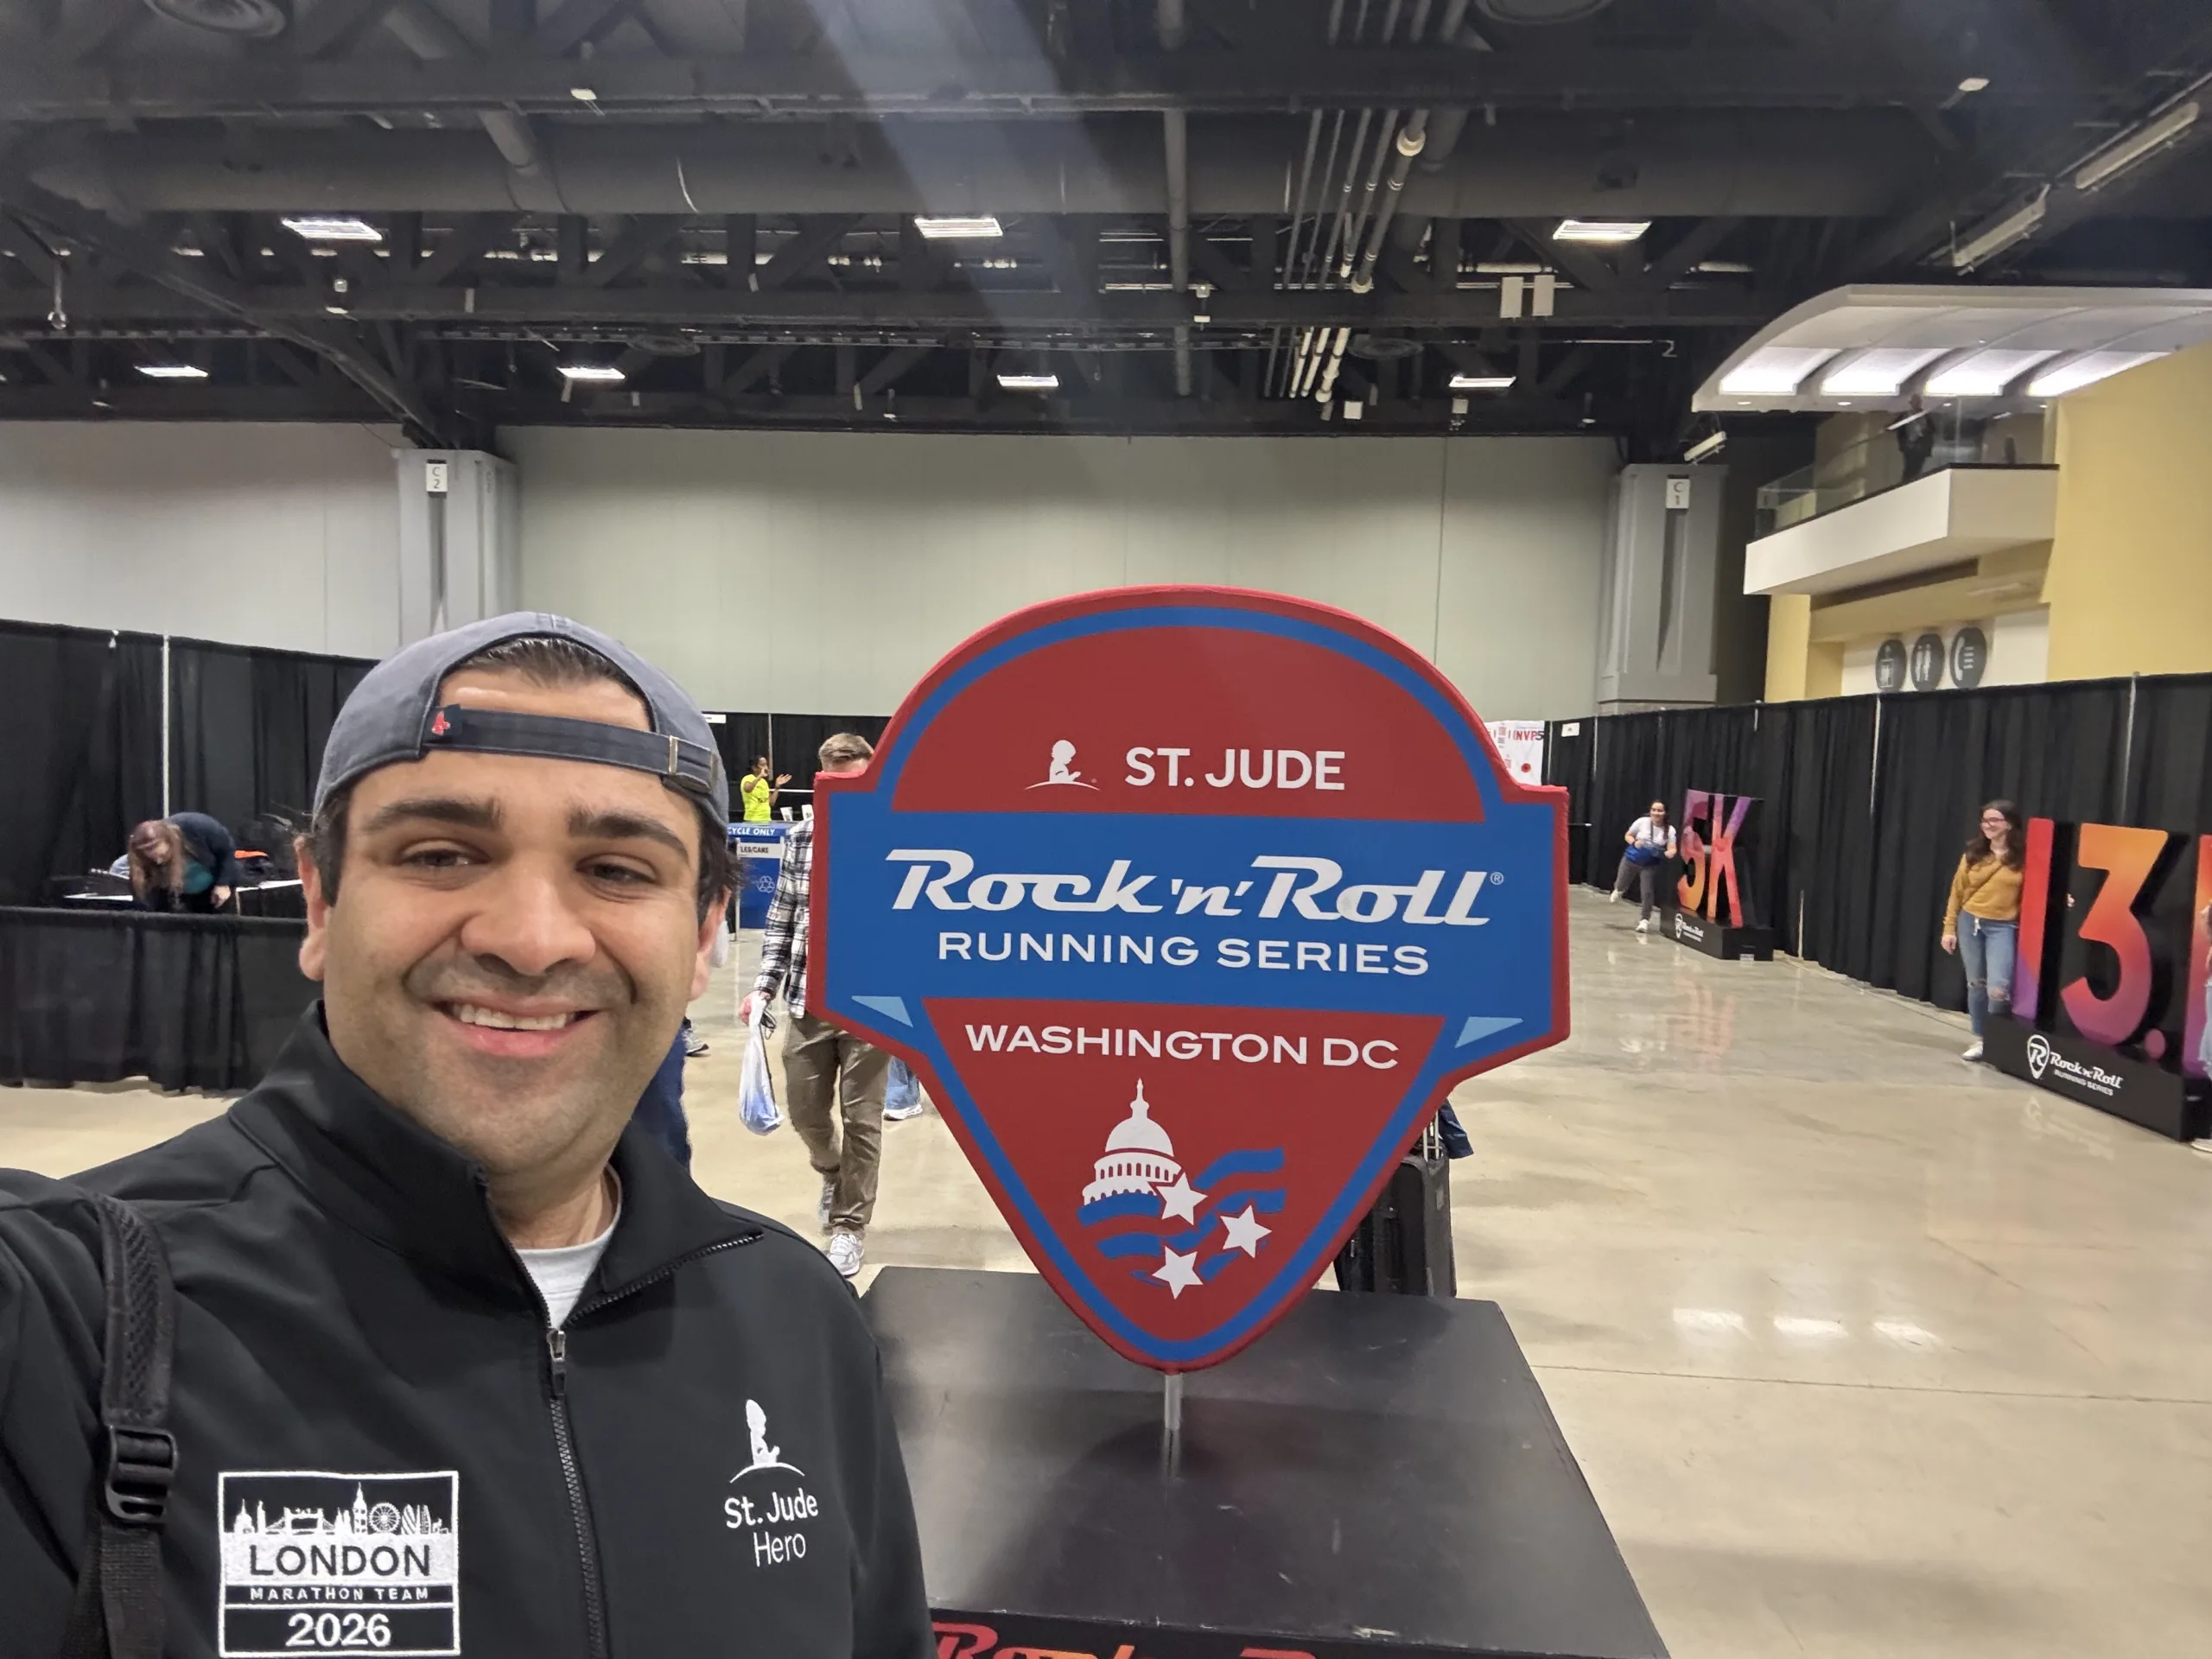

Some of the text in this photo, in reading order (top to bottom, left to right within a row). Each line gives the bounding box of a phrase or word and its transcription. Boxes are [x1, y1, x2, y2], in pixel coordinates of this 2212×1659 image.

[432, 467, 441, 477] C
[433, 479, 440, 489] 2
[1674, 482, 1683, 493] C
[1125, 747, 1345, 791] ST. JUDE
[728, 827, 750, 836] CYCLE
[1677, 789, 1751, 928] 5K
[885, 849, 1163, 913] Rock
[938, 931, 1429, 976] RUNNING SERIES
[965, 1024, 1400, 1070] WASHINGTON DC
[2050, 1051, 2082, 1074] Rock
[724, 1487, 819, 1529] St. Jude
[250, 1544, 430, 1576] LONDON
[753, 1531, 806, 1567] Hero
[250, 1587, 429, 1600] MARATHON TEAM
[285, 1612, 391, 1647] 2026
